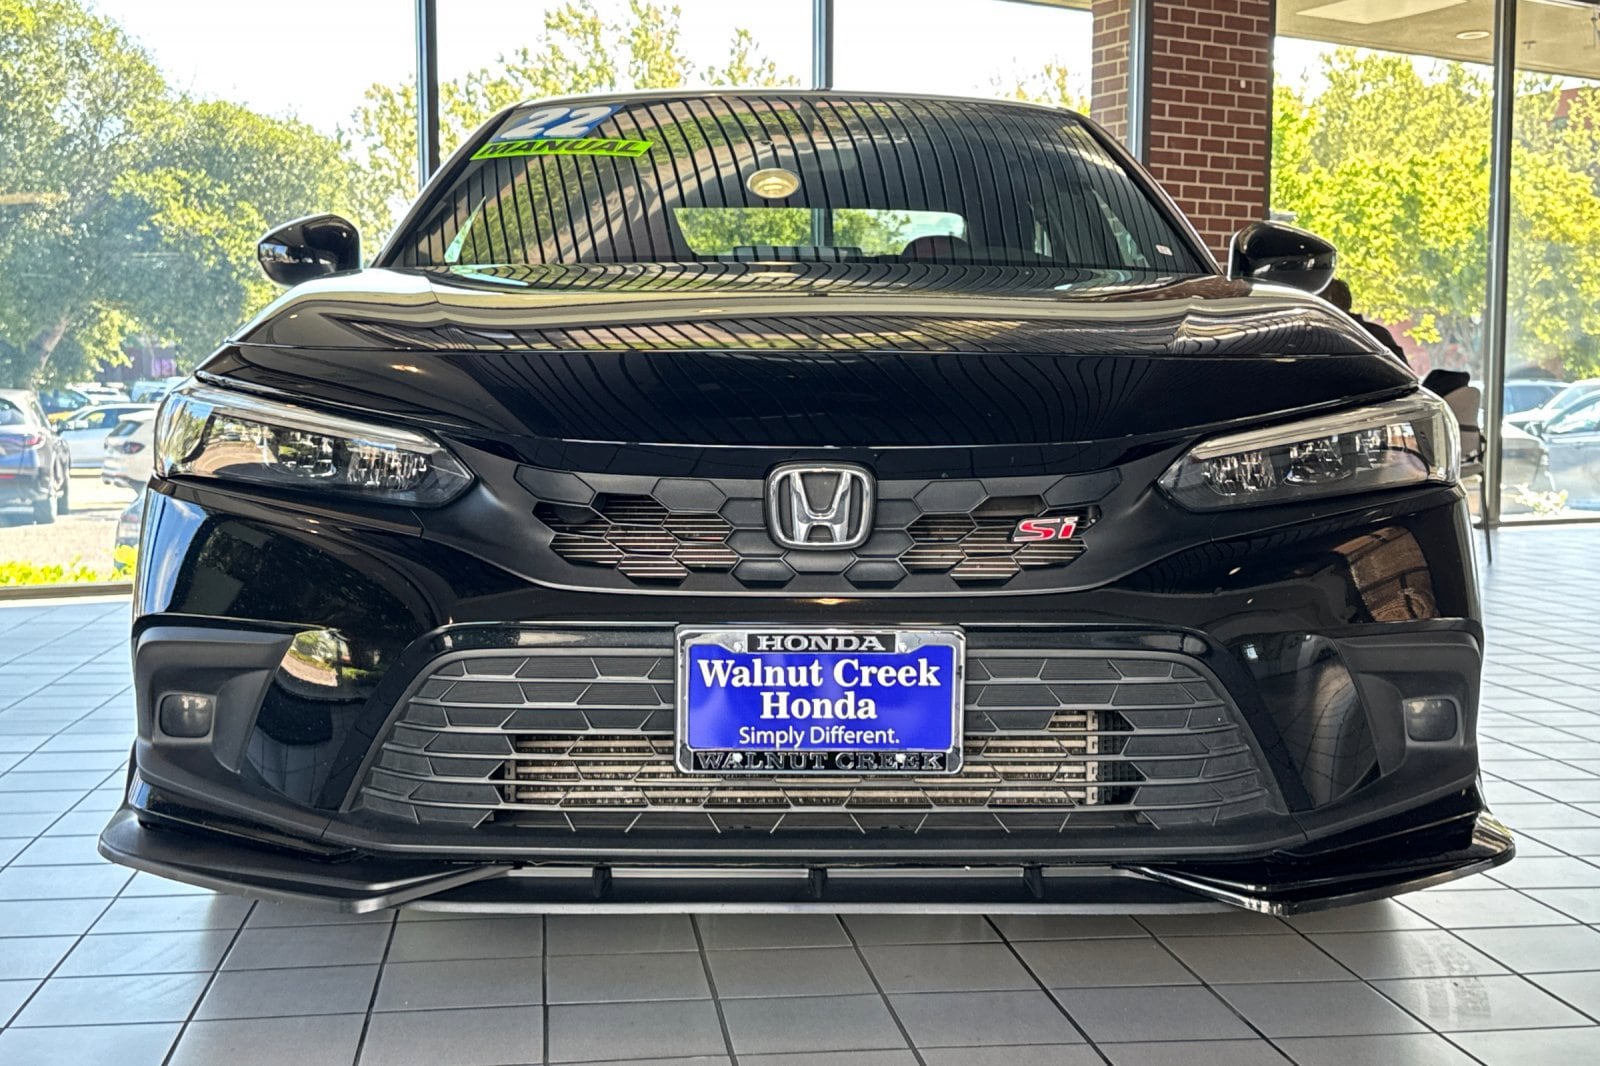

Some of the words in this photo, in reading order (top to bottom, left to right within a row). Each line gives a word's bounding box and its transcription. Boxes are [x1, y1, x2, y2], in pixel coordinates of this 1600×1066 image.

[500, 106, 612, 139] 22
[478, 140, 641, 156] MANUAL
[1013, 516, 1079, 542] Si
[756, 635, 886, 651] HONDA
[697, 658, 823, 688] Walnut
[833, 658, 941, 687] Creek
[759, 691, 877, 720] Honda
[738, 726, 805, 748] Simply
[810, 727, 900, 745] Different.
[697, 752, 828, 770] WALNUT
[835, 752, 944, 770] CREEK
